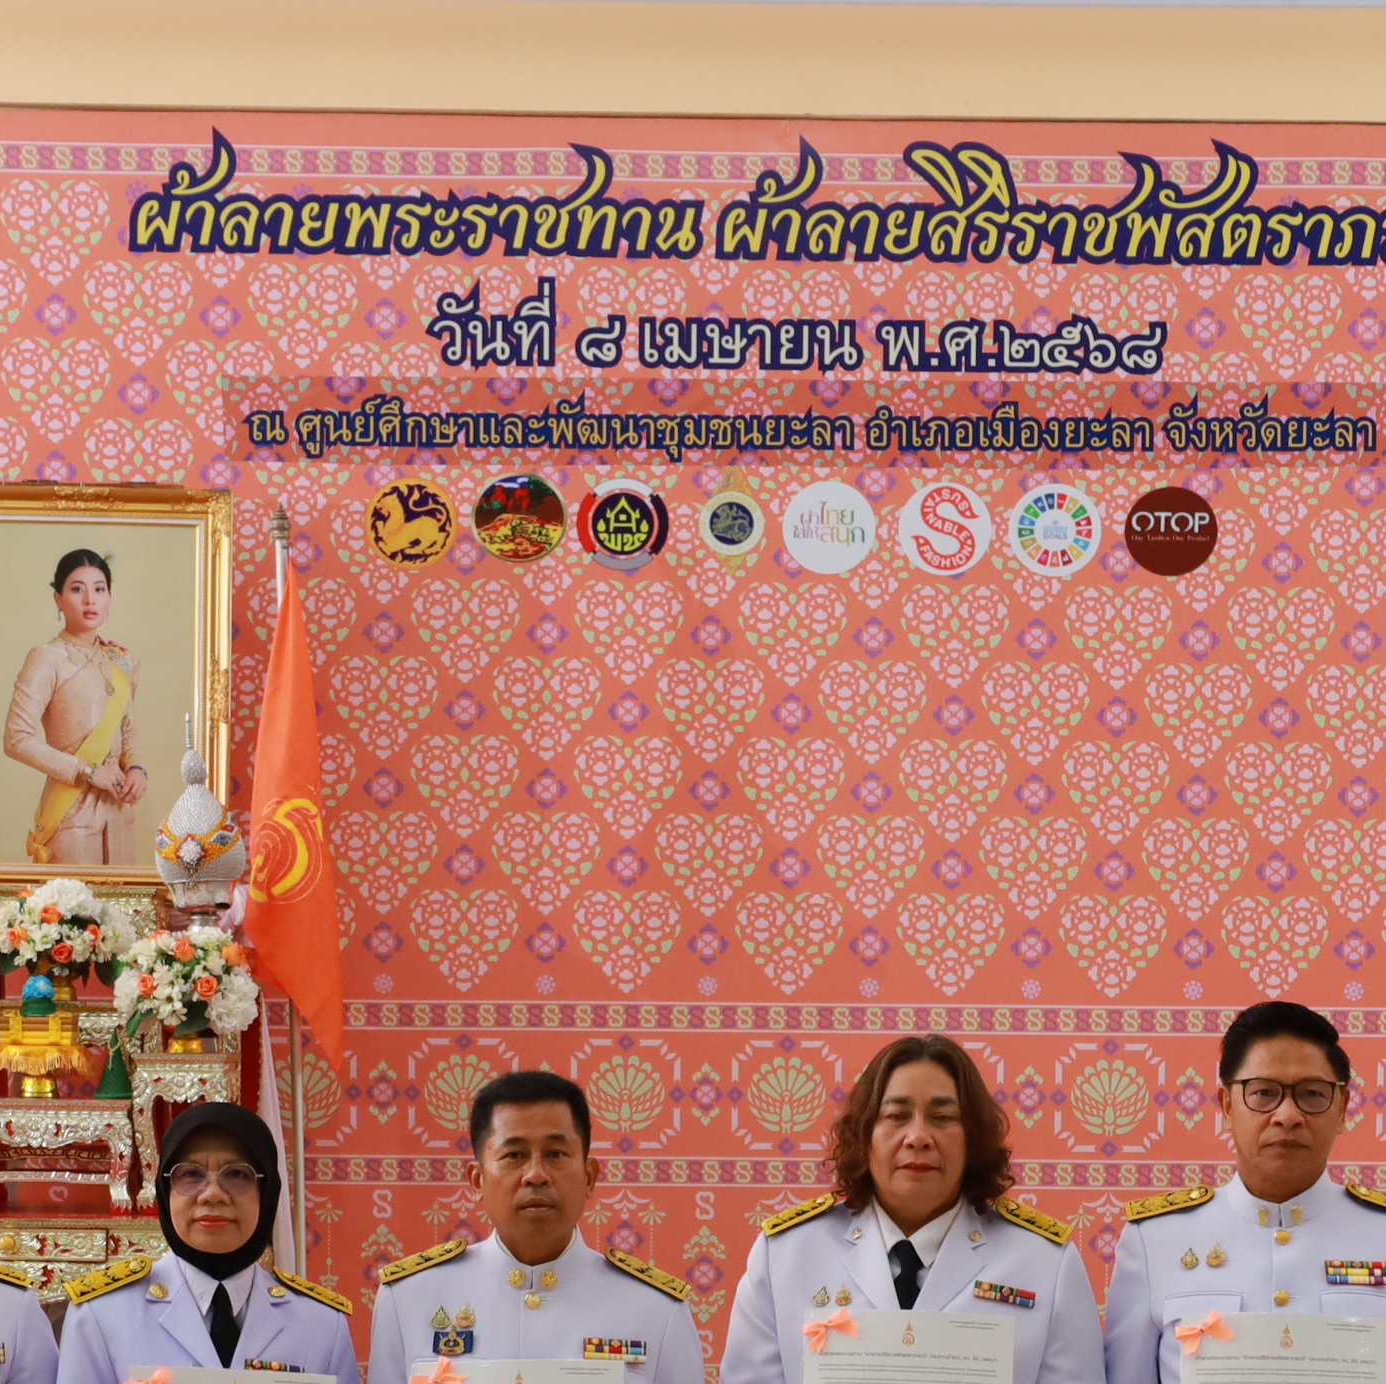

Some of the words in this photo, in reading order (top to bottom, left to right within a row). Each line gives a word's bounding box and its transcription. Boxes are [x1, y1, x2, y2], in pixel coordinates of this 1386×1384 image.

[132, 130, 699, 257] ผ้าลายพระราชทาน
[432, 283, 553, 367] วันที่
[580, 317, 621, 366] ๘
[642, 318, 860, 371] เมษายน
[882, 318, 1165, 372] พ.ศ.๒๕๖๘
[250, 411, 285, 443] ณ
[299, 399, 853, 458] ศูนย์ศึกษาและพัฒนาชุมชนยะลา
[867, 405, 1151, 451] อำเภอเมืองยะลา
[1166, 404, 1375, 452] จังหวัดยะลา
[923, 488, 972, 542] SUSTAINABLE
[1131, 511, 1210, 533] OTOP
[920, 544, 973, 568] FASHION
